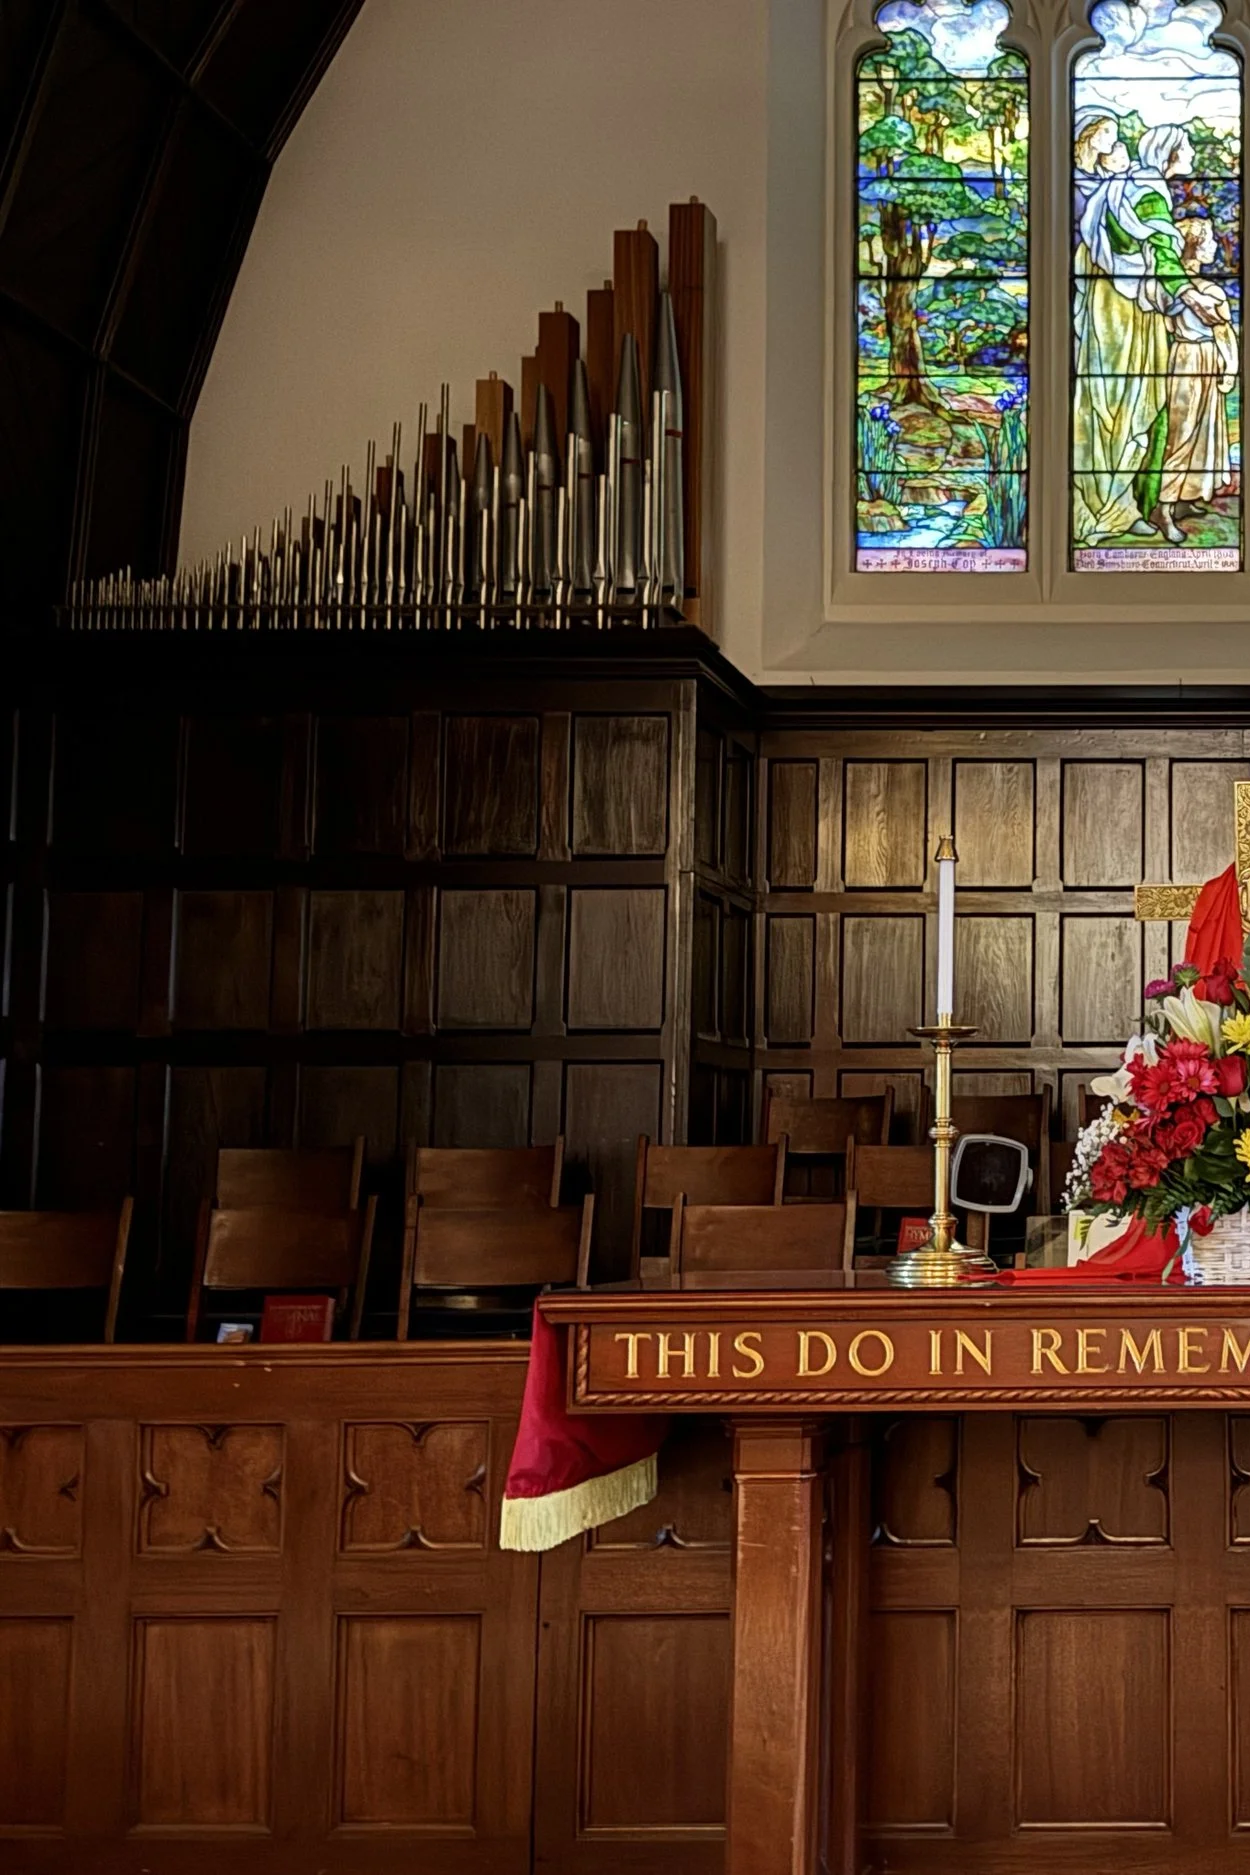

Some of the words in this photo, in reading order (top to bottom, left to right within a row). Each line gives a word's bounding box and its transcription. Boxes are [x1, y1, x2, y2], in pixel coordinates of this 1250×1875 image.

[615, 1332, 766, 1379] THIS
[797, 1331, 896, 1378] DO
[929, 1330, 993, 1376] IN
